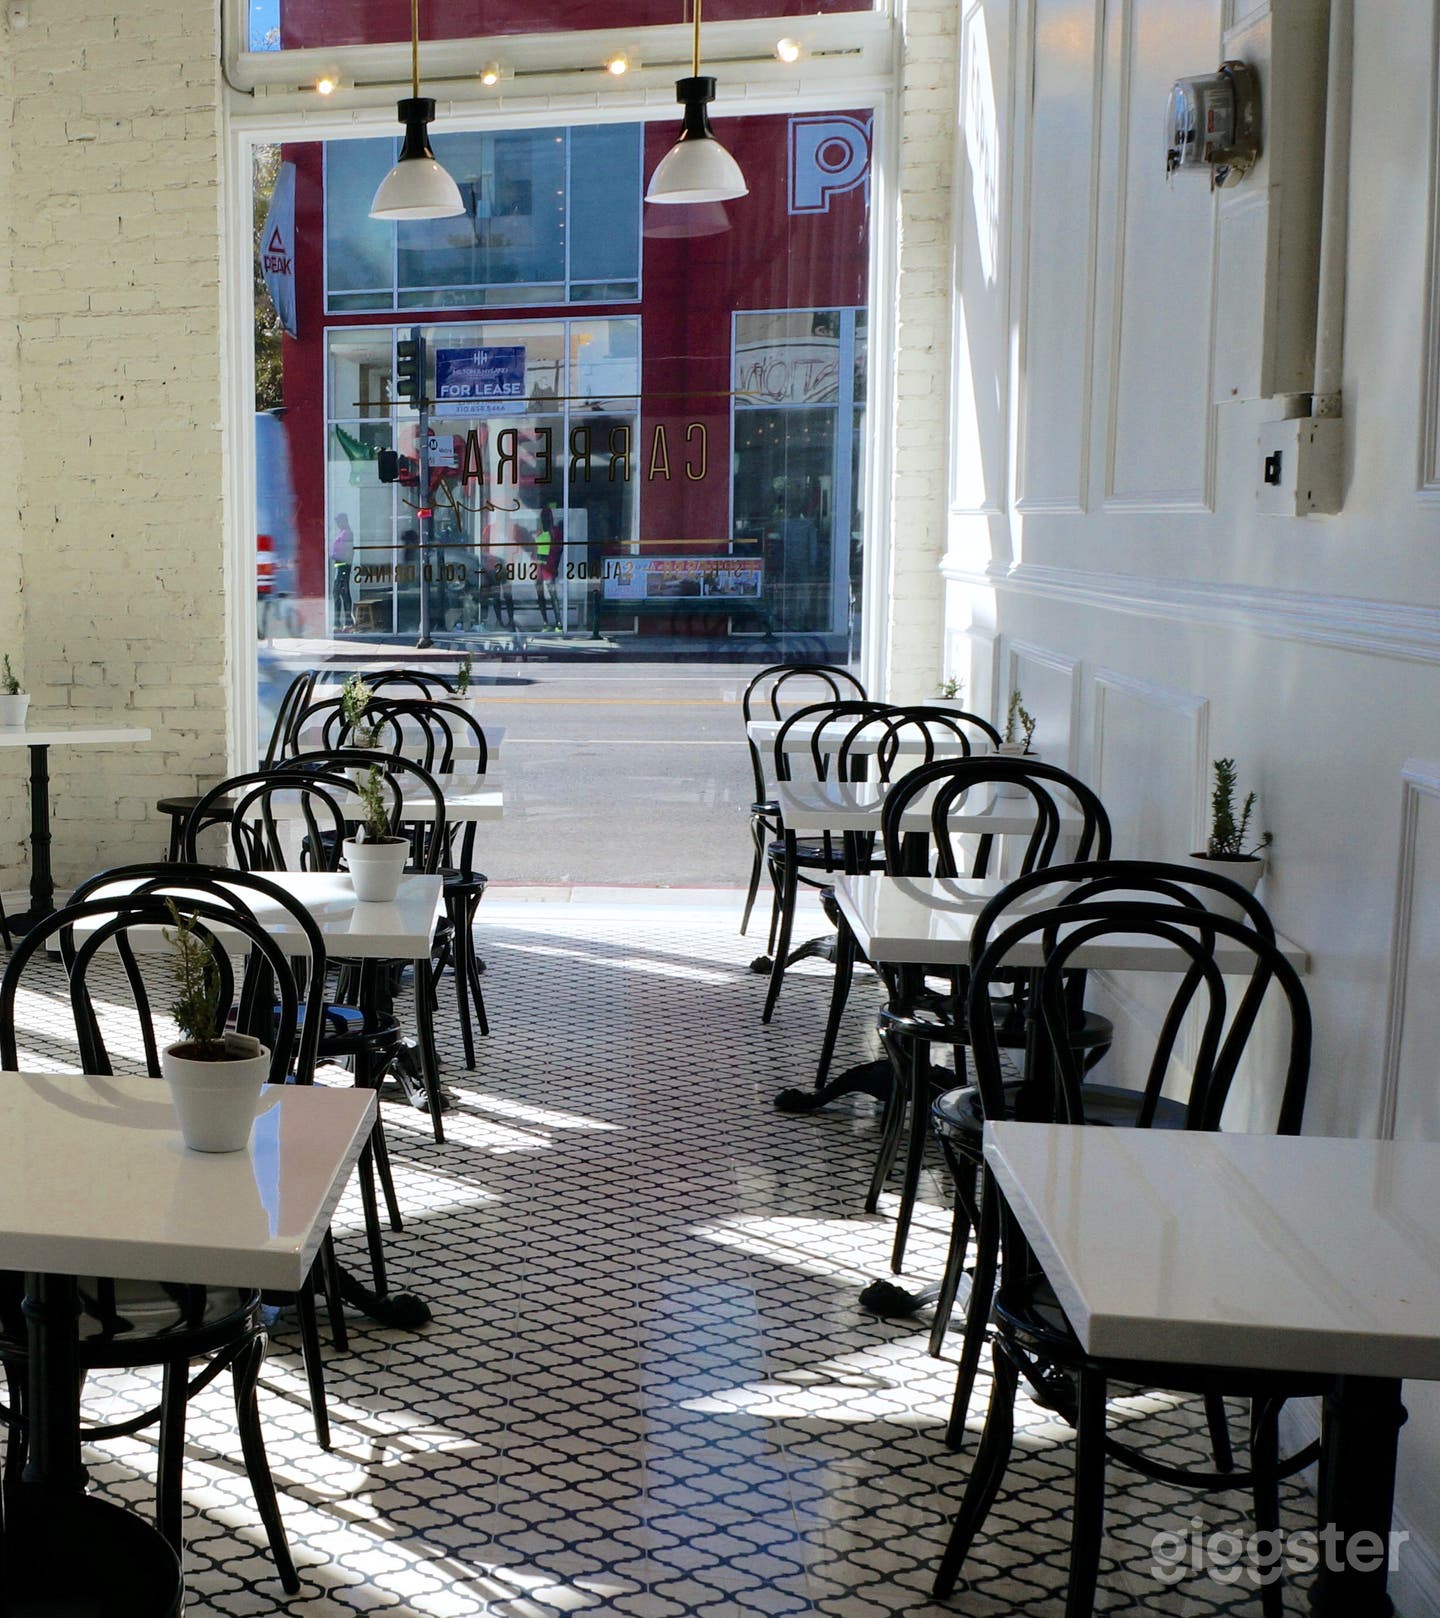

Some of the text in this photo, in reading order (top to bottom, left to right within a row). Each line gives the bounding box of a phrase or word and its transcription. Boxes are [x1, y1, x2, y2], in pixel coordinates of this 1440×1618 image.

[263, 255, 292, 275] PEAK
[440, 382, 521, 397] FOR LEASE
